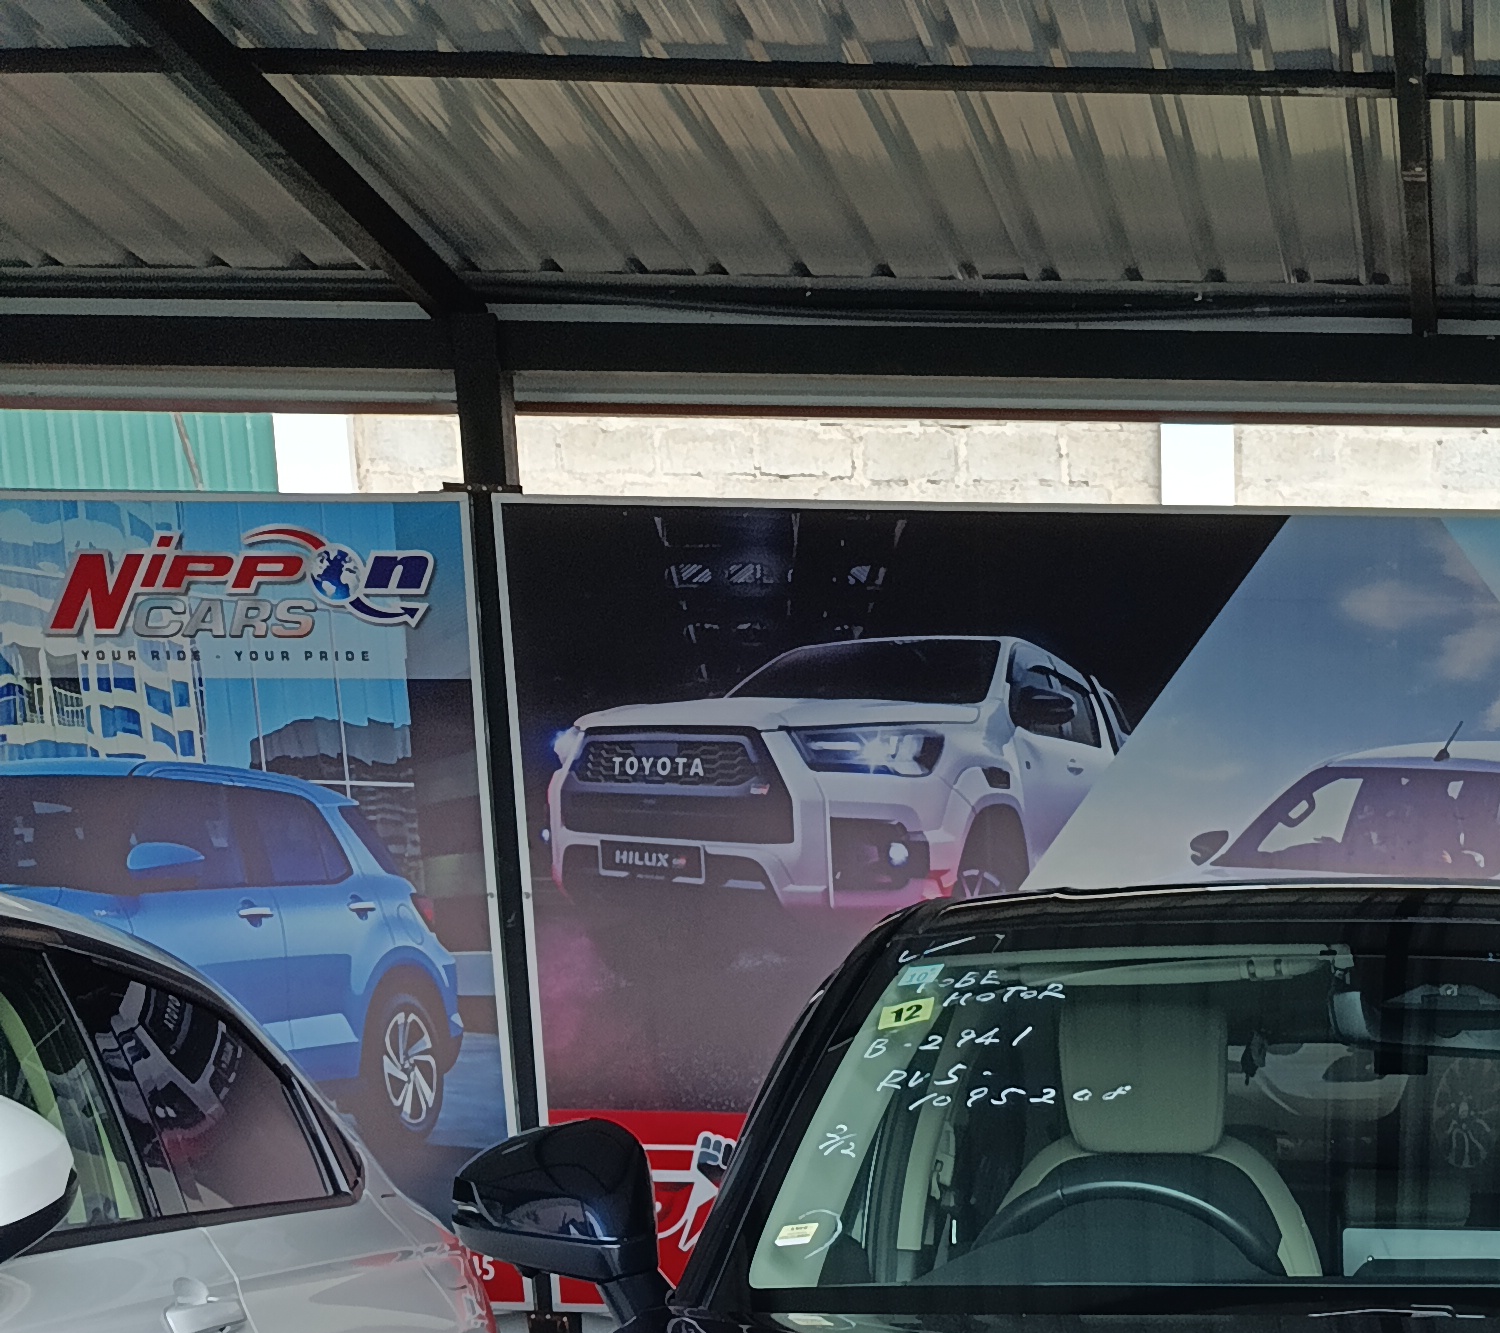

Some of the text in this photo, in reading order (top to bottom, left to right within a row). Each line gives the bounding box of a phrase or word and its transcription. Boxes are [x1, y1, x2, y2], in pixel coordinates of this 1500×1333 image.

[133, 598, 318, 639] CARS
[81, 649, 137, 662] YOUR
[150, 649, 201, 662] RIDE
[234, 650, 291, 663] YOUR
[304, 650, 372, 663] PRIDE
[612, 756, 704, 777] TOYOTA
[615, 849, 669, 867] HILUX
[917, 970, 1001, 993] OBE
[891, 1004, 923, 1023] 12
